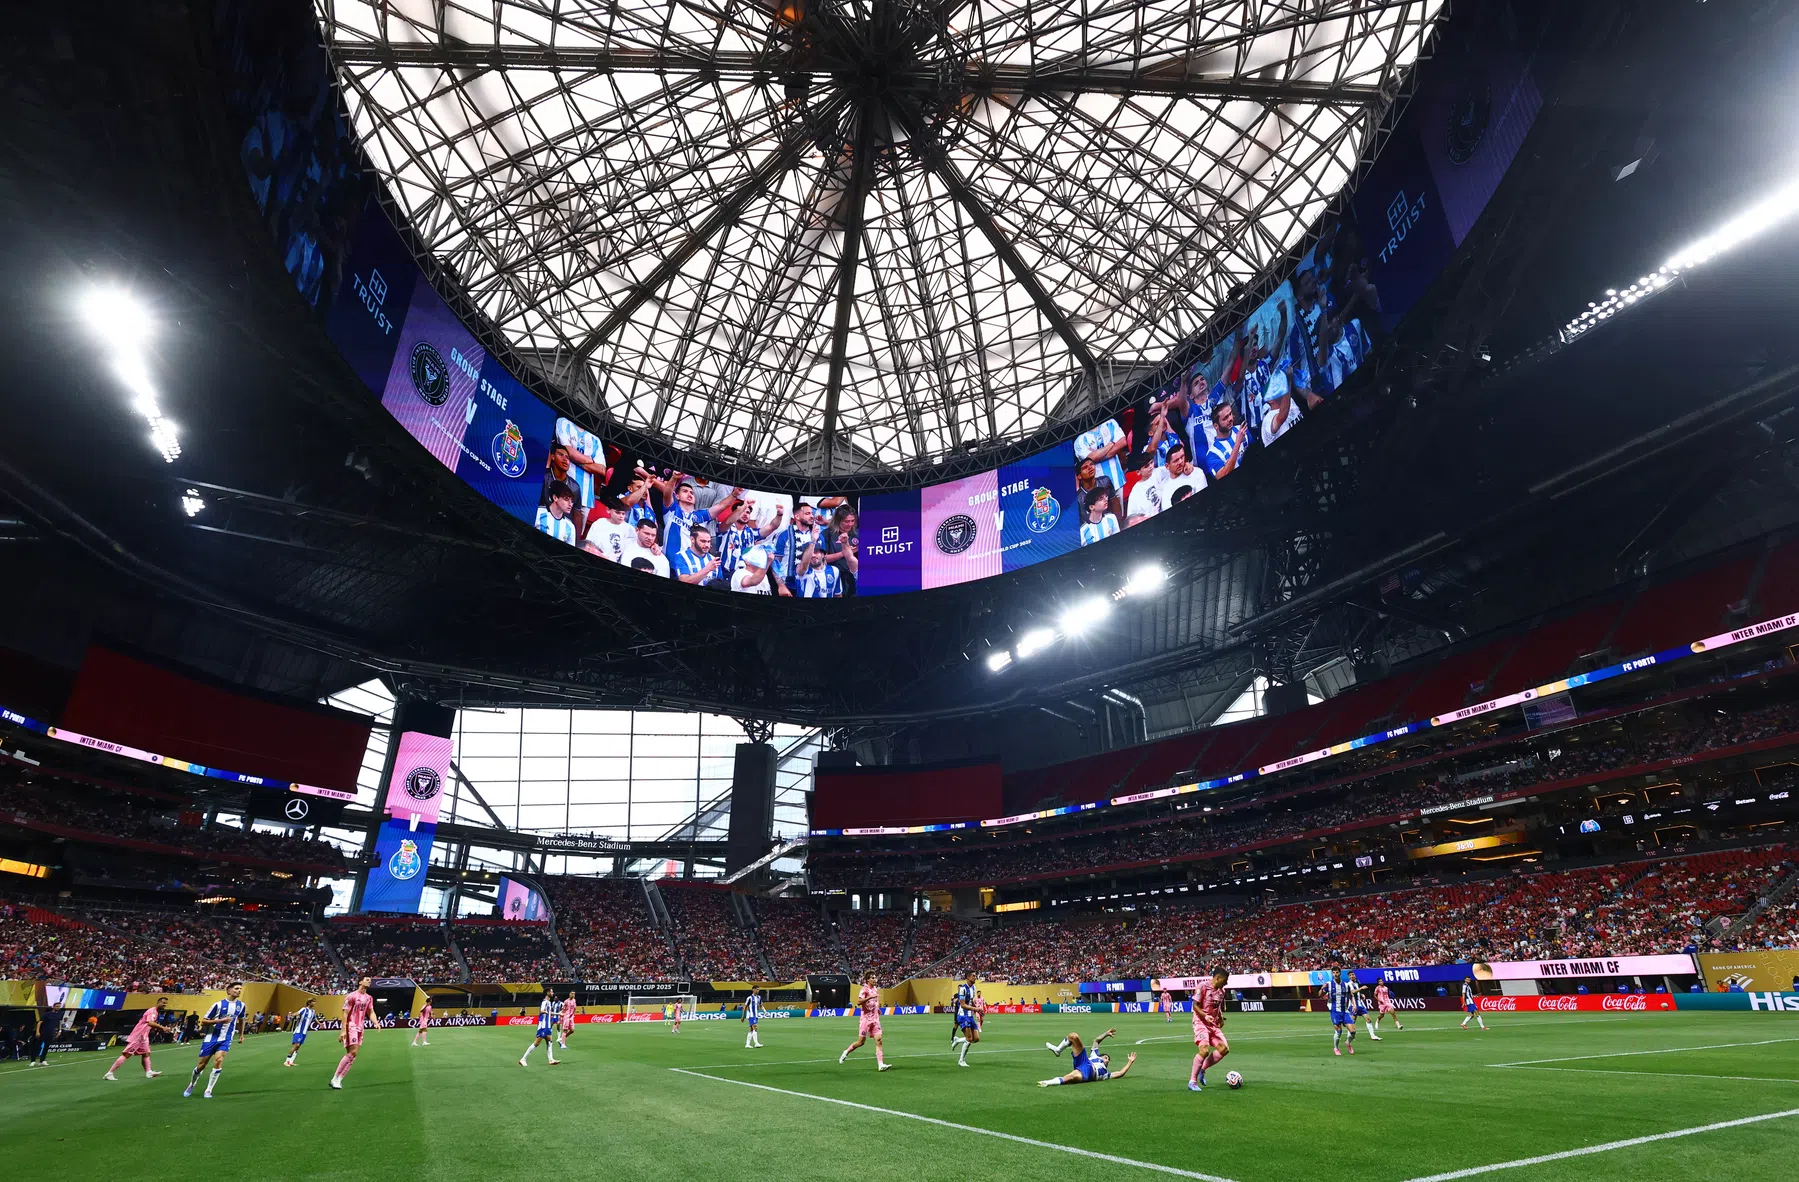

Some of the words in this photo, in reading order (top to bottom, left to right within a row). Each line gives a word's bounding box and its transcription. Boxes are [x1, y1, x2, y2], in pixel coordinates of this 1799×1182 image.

[1379, 192, 1426, 263] TRUIST
[353, 273, 393, 335] TRUIST
[450, 347, 479, 381] GROUP
[480, 378, 508, 411] STAGE
[466, 398, 478, 425] V
[454, 436, 470, 454] WORLD
[470, 450, 479, 462] CUP
[968, 489, 998, 506] GROUP
[1001, 478, 1030, 496] STAGE
[994, 510, 1004, 531] V
[866, 542, 914, 556] TRUIST
[1732, 628, 1754, 640] INTER
[1756, 620, 1784, 634] MIAMI
[1786, 616, 1796, 626] CF
[1622, 663, 1632, 672] FC
[1632, 656, 1656, 669] PORTO
[1456, 708, 1470, 718] INTER
[1471, 704, 1490, 714] MIAMI
[1490, 701, 1496, 709] CF
[2, 710, 10, 718] FC
[9, 712, 26, 724] PORTO
[1386, 730, 1394, 738] FC
[1394, 726, 1408, 736] PORTO
[80, 736, 96, 746] INTER
[96, 740, 115, 752] MIAMI
[238, 774, 246, 782] FC
[246, 776, 263, 784] PORTO
[316, 788, 330, 796] INTER
[331, 790, 345, 799] MIAMI
[1420, 802, 1466, 816] Mercedes-Benz
[1466, 796, 1494, 806] Stadium
[409, 812, 422, 832] V
[536, 837, 597, 848] Mercedes-Benz
[599, 840, 630, 850] Stadium
[1456, 841, 1474, 850] 36:10
[1540, 963, 1568, 976] INTER
[1570, 962, 1604, 974] MIAMI
[1607, 960, 1620, 974] CF
[1384, 970, 1394, 982] FC
[1395, 970, 1420, 981] PORTO
[1112, 982, 1124, 990] PORTO
[1182, 980, 1196, 988] INTER
[1059, 1004, 1092, 1013] Hisense
[1124, 1003, 1142, 1012] VISA
[1242, 1002, 1264, 1012] ATLANTA
[1389, 998, 1426, 1009] RWAYS
[1480, 997, 1516, 1010] Coca-Cola
[1538, 996, 1578, 1010] Coca-Cola
[1602, 996, 1646, 1010] Coca-Cola
[818, 1008, 836, 1017] VISA
[900, 1006, 918, 1014] VISA
[408, 1018, 442, 1028] QAAR
[446, 1017, 486, 1026] AIRWAYS
[509, 1016, 534, 1025] Coca-Cola
[591, 1014, 614, 1022] Coca-Cola
